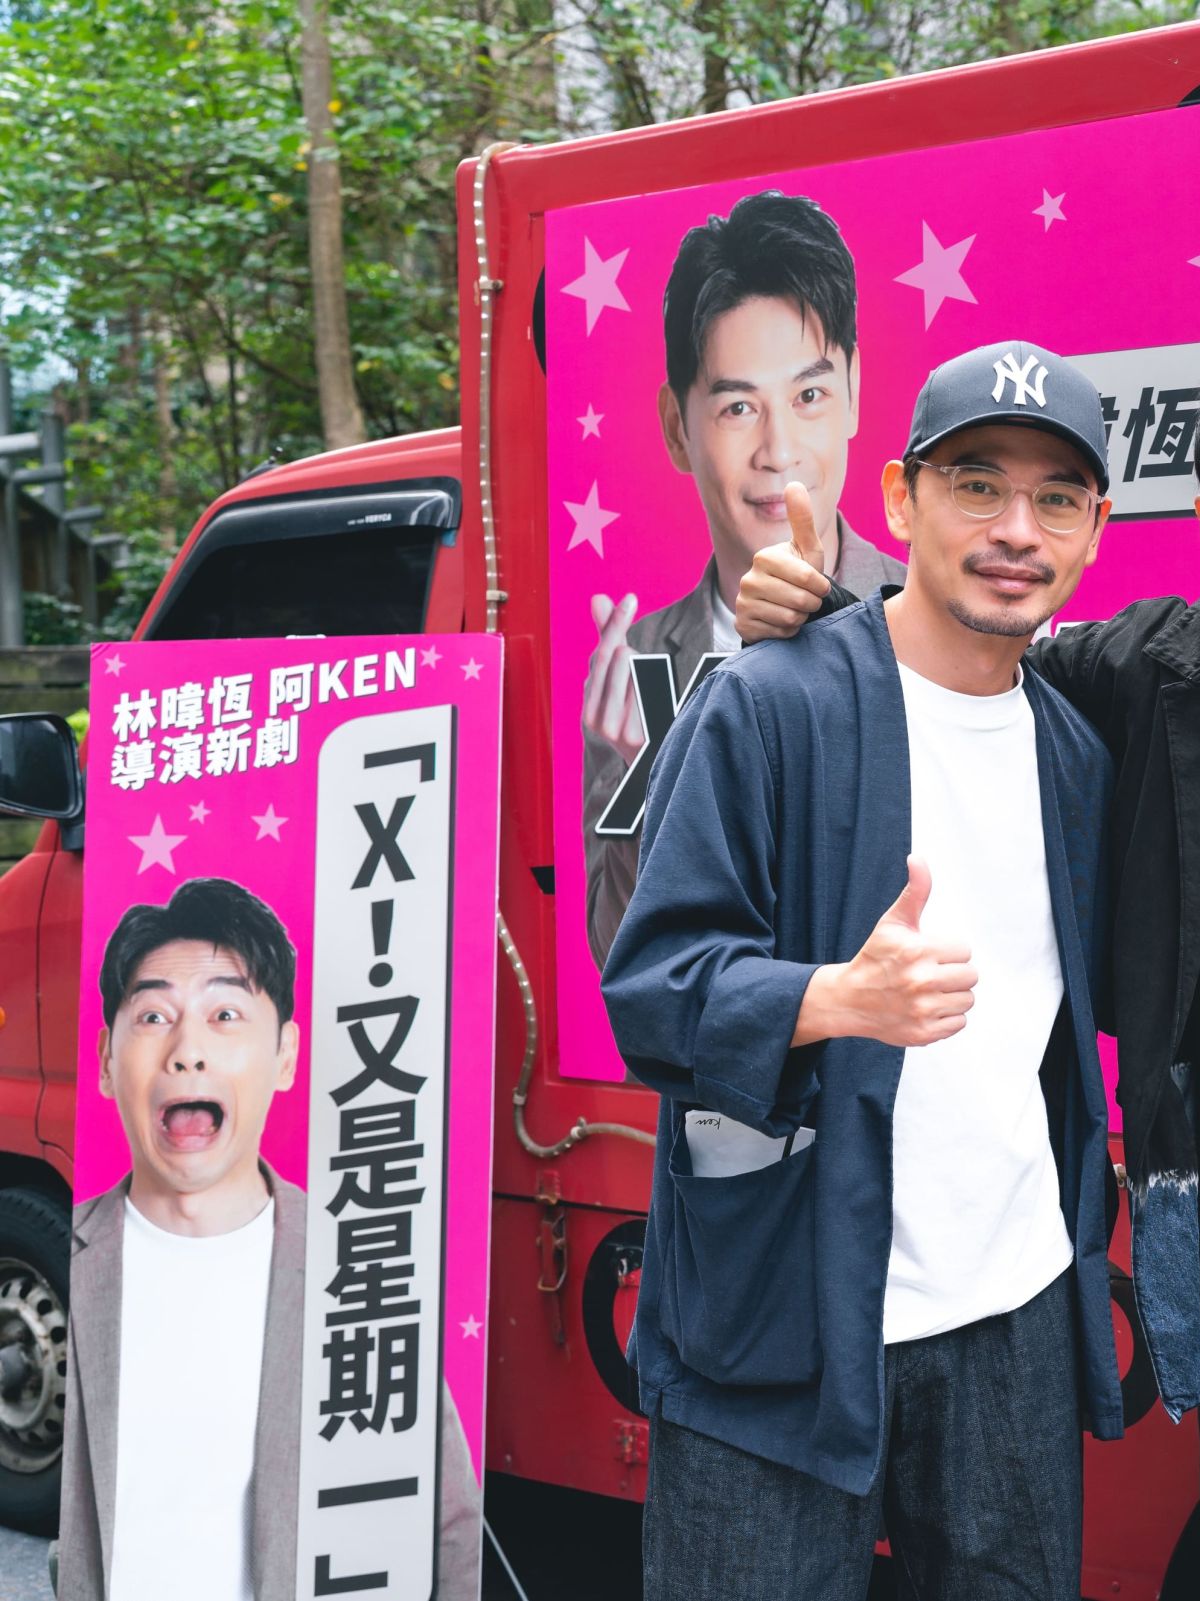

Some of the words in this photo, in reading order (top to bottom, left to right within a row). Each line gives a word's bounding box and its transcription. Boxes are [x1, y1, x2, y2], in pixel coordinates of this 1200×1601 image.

[111, 672, 254, 743] 林暐恆
[268, 646, 416, 717] 阿KEN
[110, 714, 299, 792] 導演新劇
